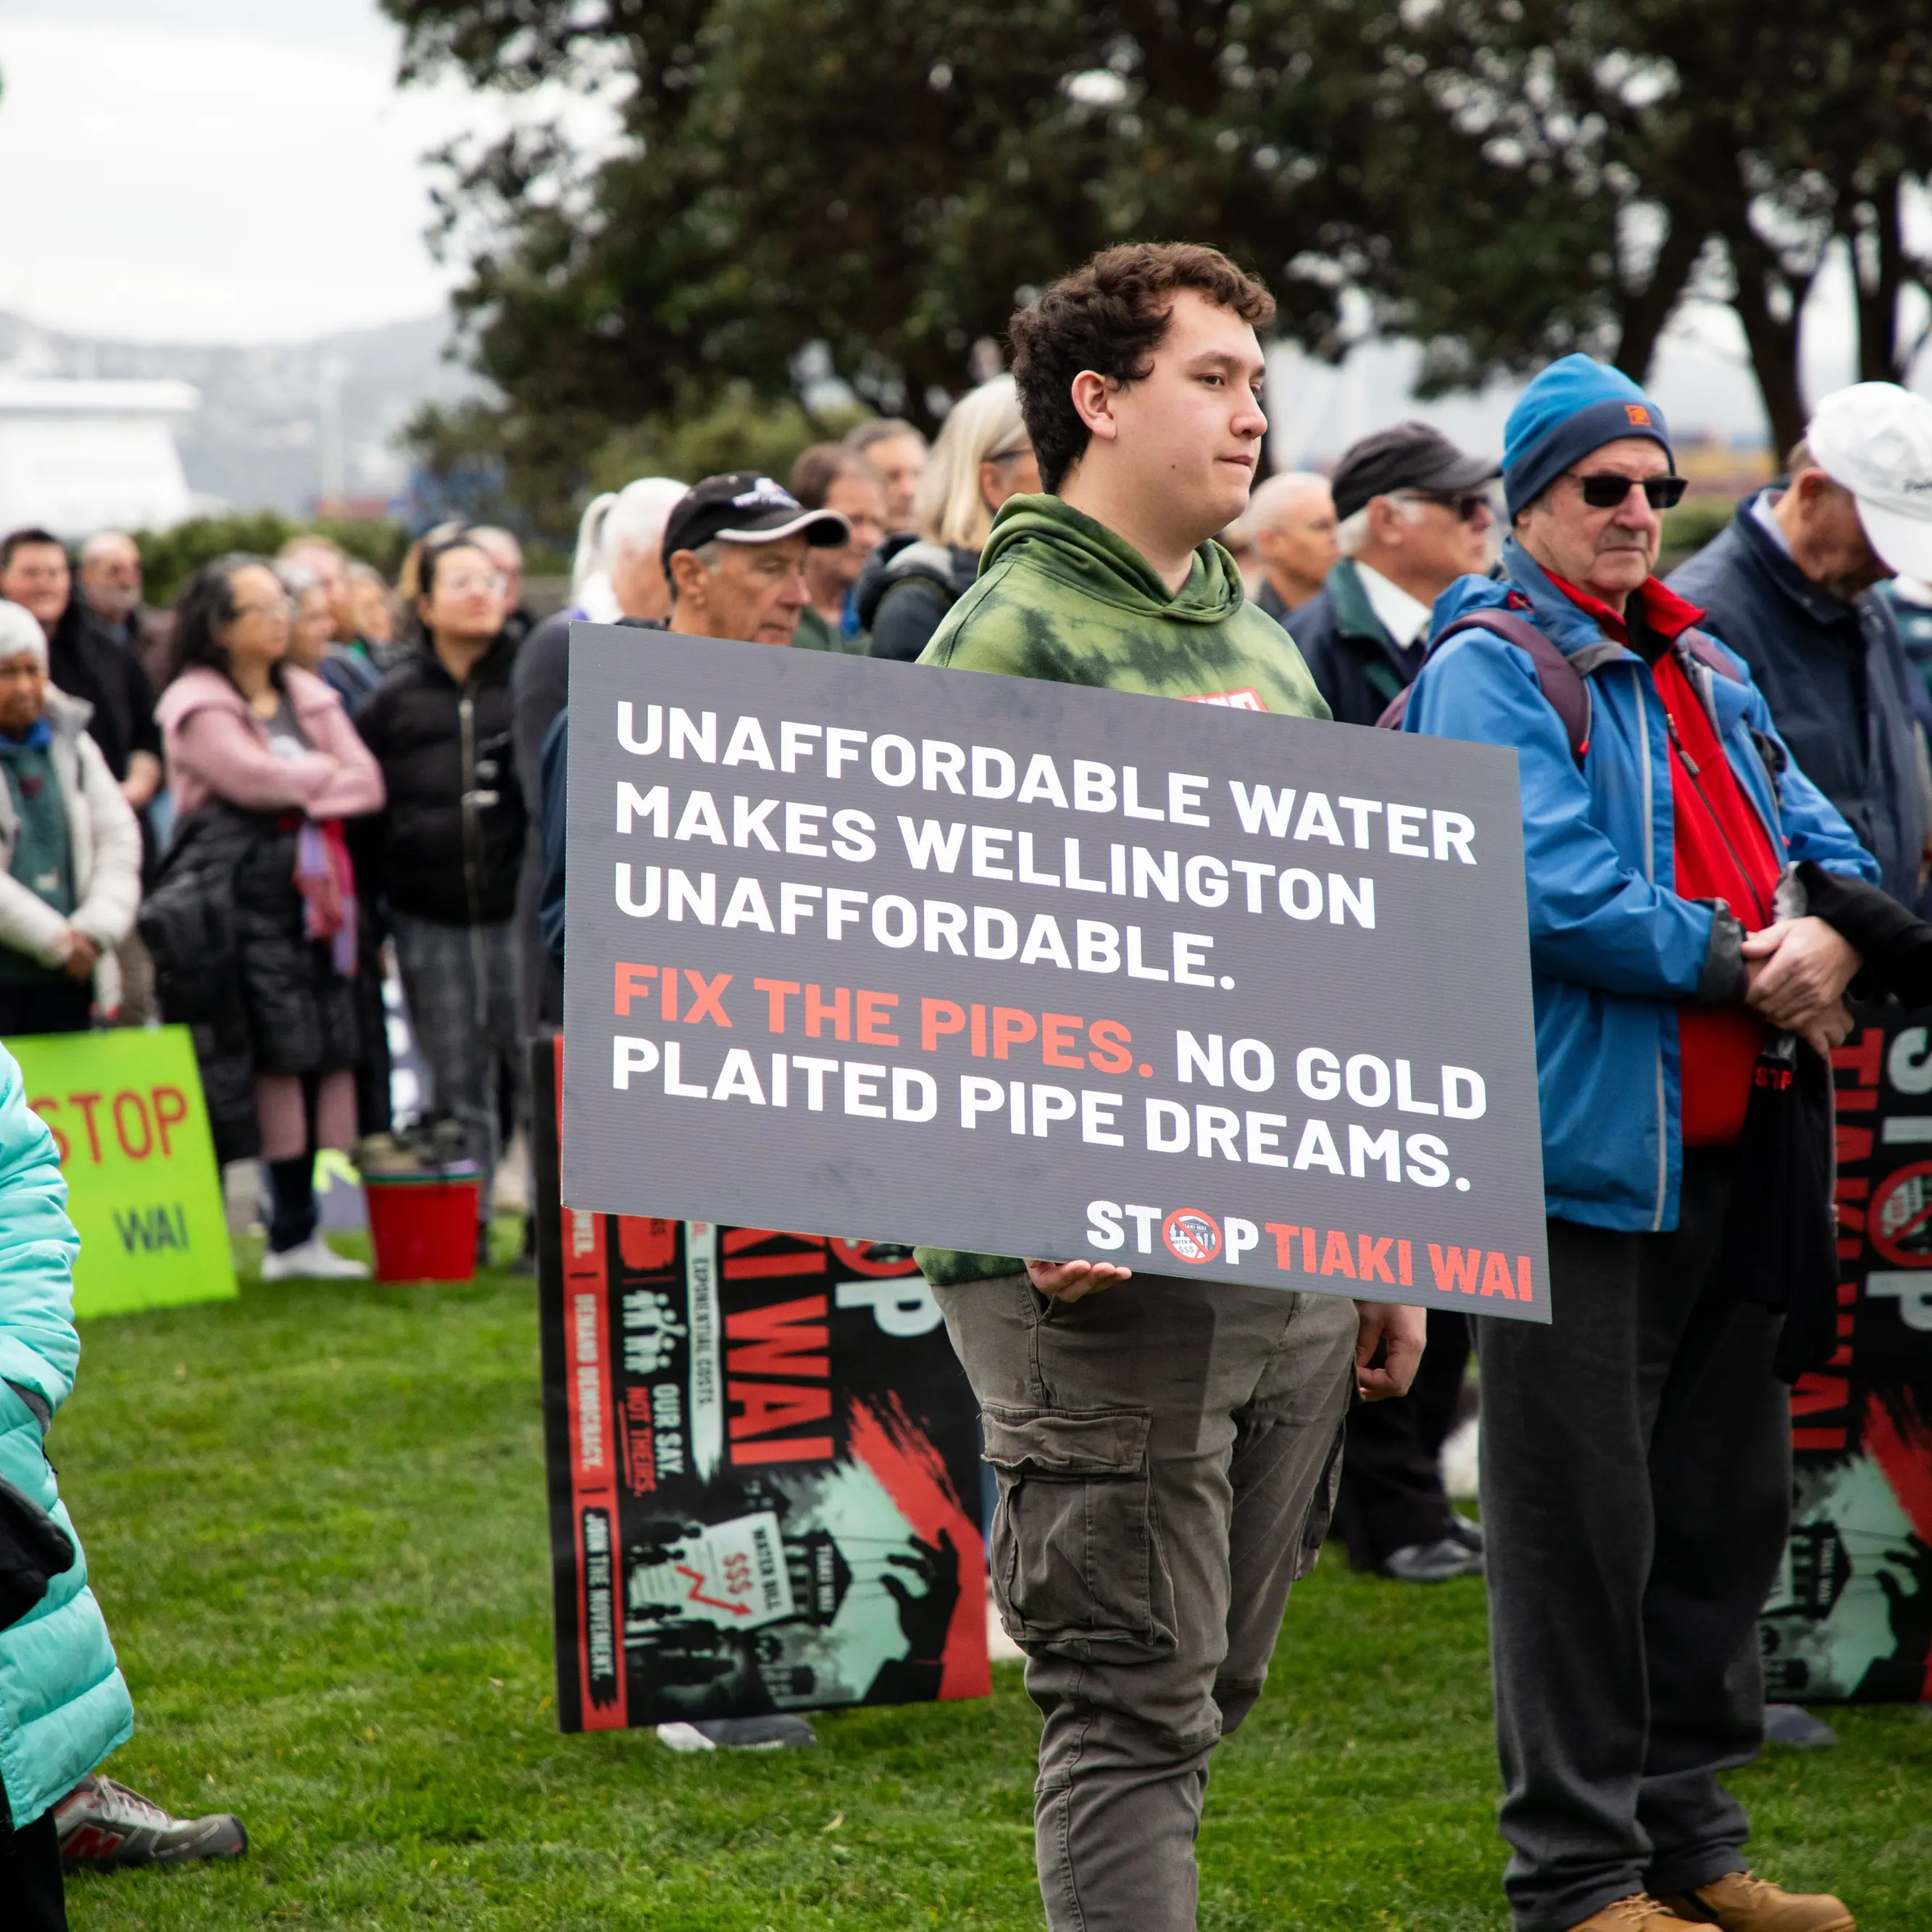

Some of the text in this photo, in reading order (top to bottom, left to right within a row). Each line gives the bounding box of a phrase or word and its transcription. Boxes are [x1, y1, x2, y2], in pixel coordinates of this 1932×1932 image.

[617, 701, 1477, 865] UNAFFORDABLE WATER
[617, 781, 1375, 928] MAKES WELLINGTON
[615, 862, 1235, 990] UNAFFORDABLE.
[615, 962, 1486, 1119] FIX THE PIPES. NO GOLD
[613, 1036, 1470, 1191] PLAITED PIPE DREAMS.
[112, 1203, 190, 1257] WAI
[1265, 1223, 1412, 1286] TIAKI
[1428, 1244, 1532, 1301] WAI
[575, 1294, 597, 1363] DEMAND
[692, 1257, 712, 1354] EXPONENTIAL
[577, 1365, 604, 1473] DEMOCRACY.
[653, 1383, 684, 1480] OUR SAY.
[725, 1294, 834, 1467] WAI
[625, 1386, 658, 1498] NOT THEIRS.
[585, 1513, 615, 1681] JOIN THE MOVEMENT.
[753, 1525, 783, 1611] WATER BILL
